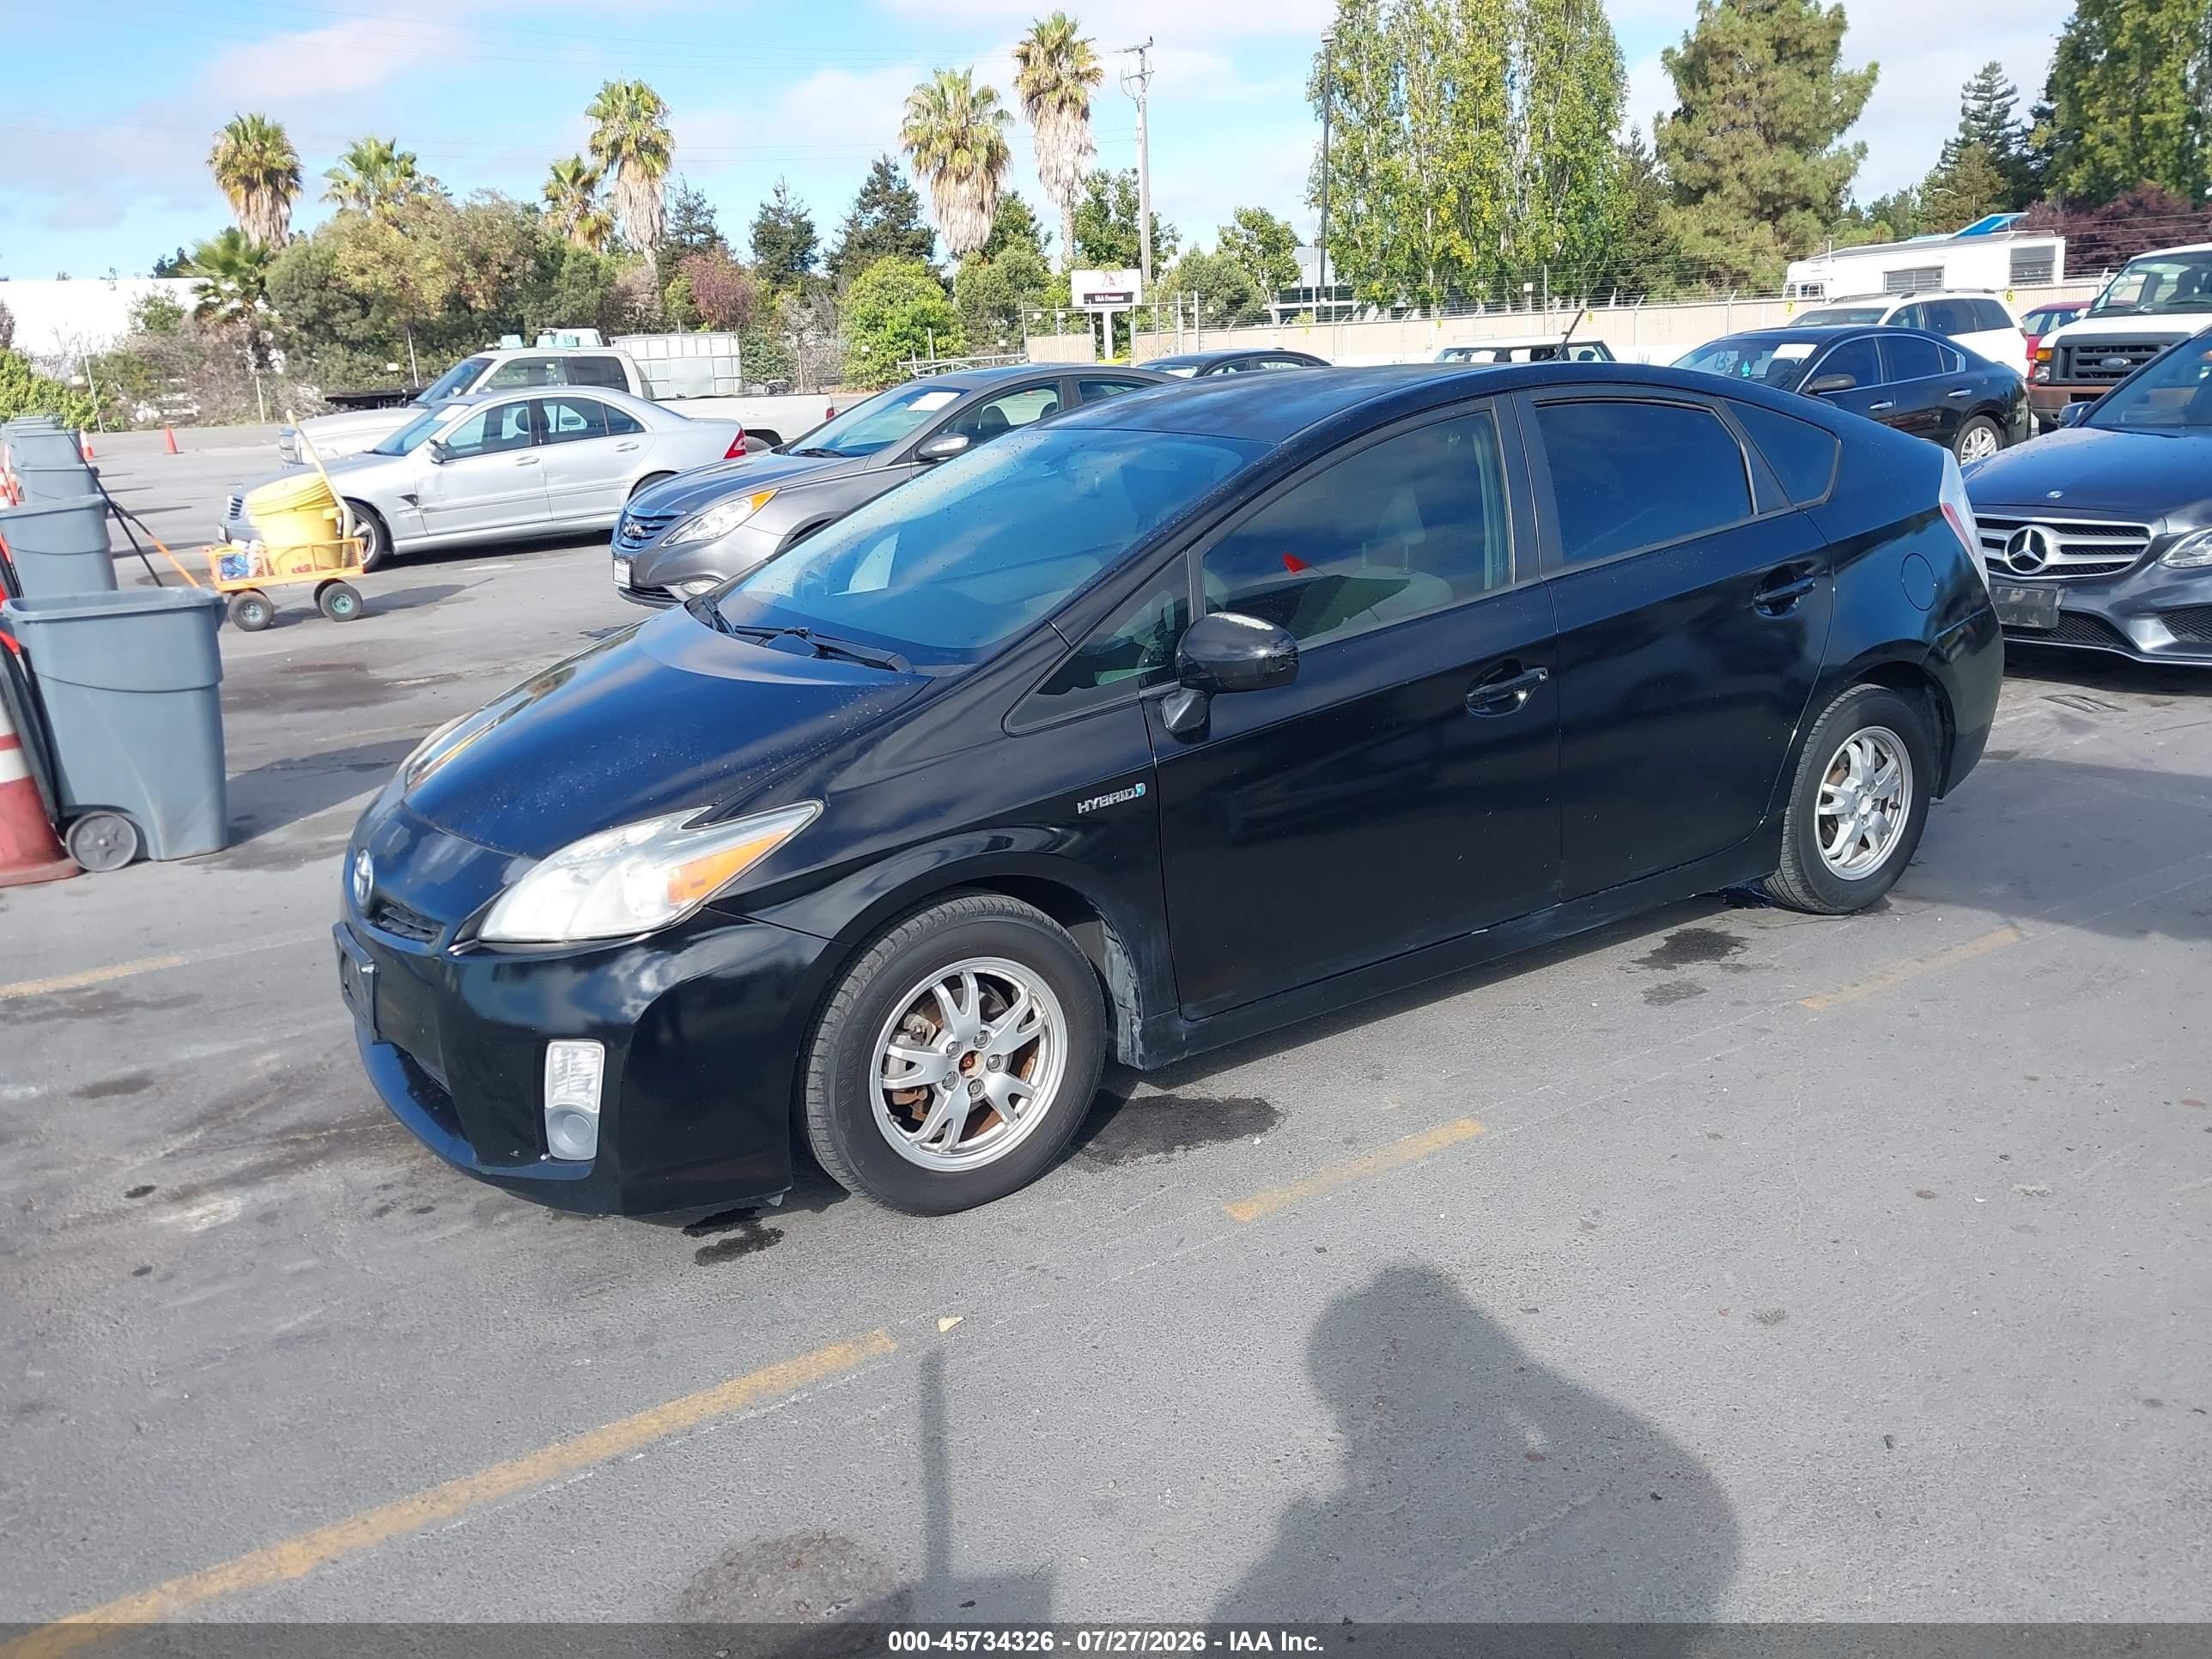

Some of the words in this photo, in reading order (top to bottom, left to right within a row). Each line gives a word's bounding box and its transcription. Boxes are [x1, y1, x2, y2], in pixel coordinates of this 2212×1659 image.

[2006, 290, 2013, 301] 6
[1788, 302, 1793, 313] 7
[1588, 312, 1593, 322] 8
[1077, 787, 1135, 814] HYBRID
